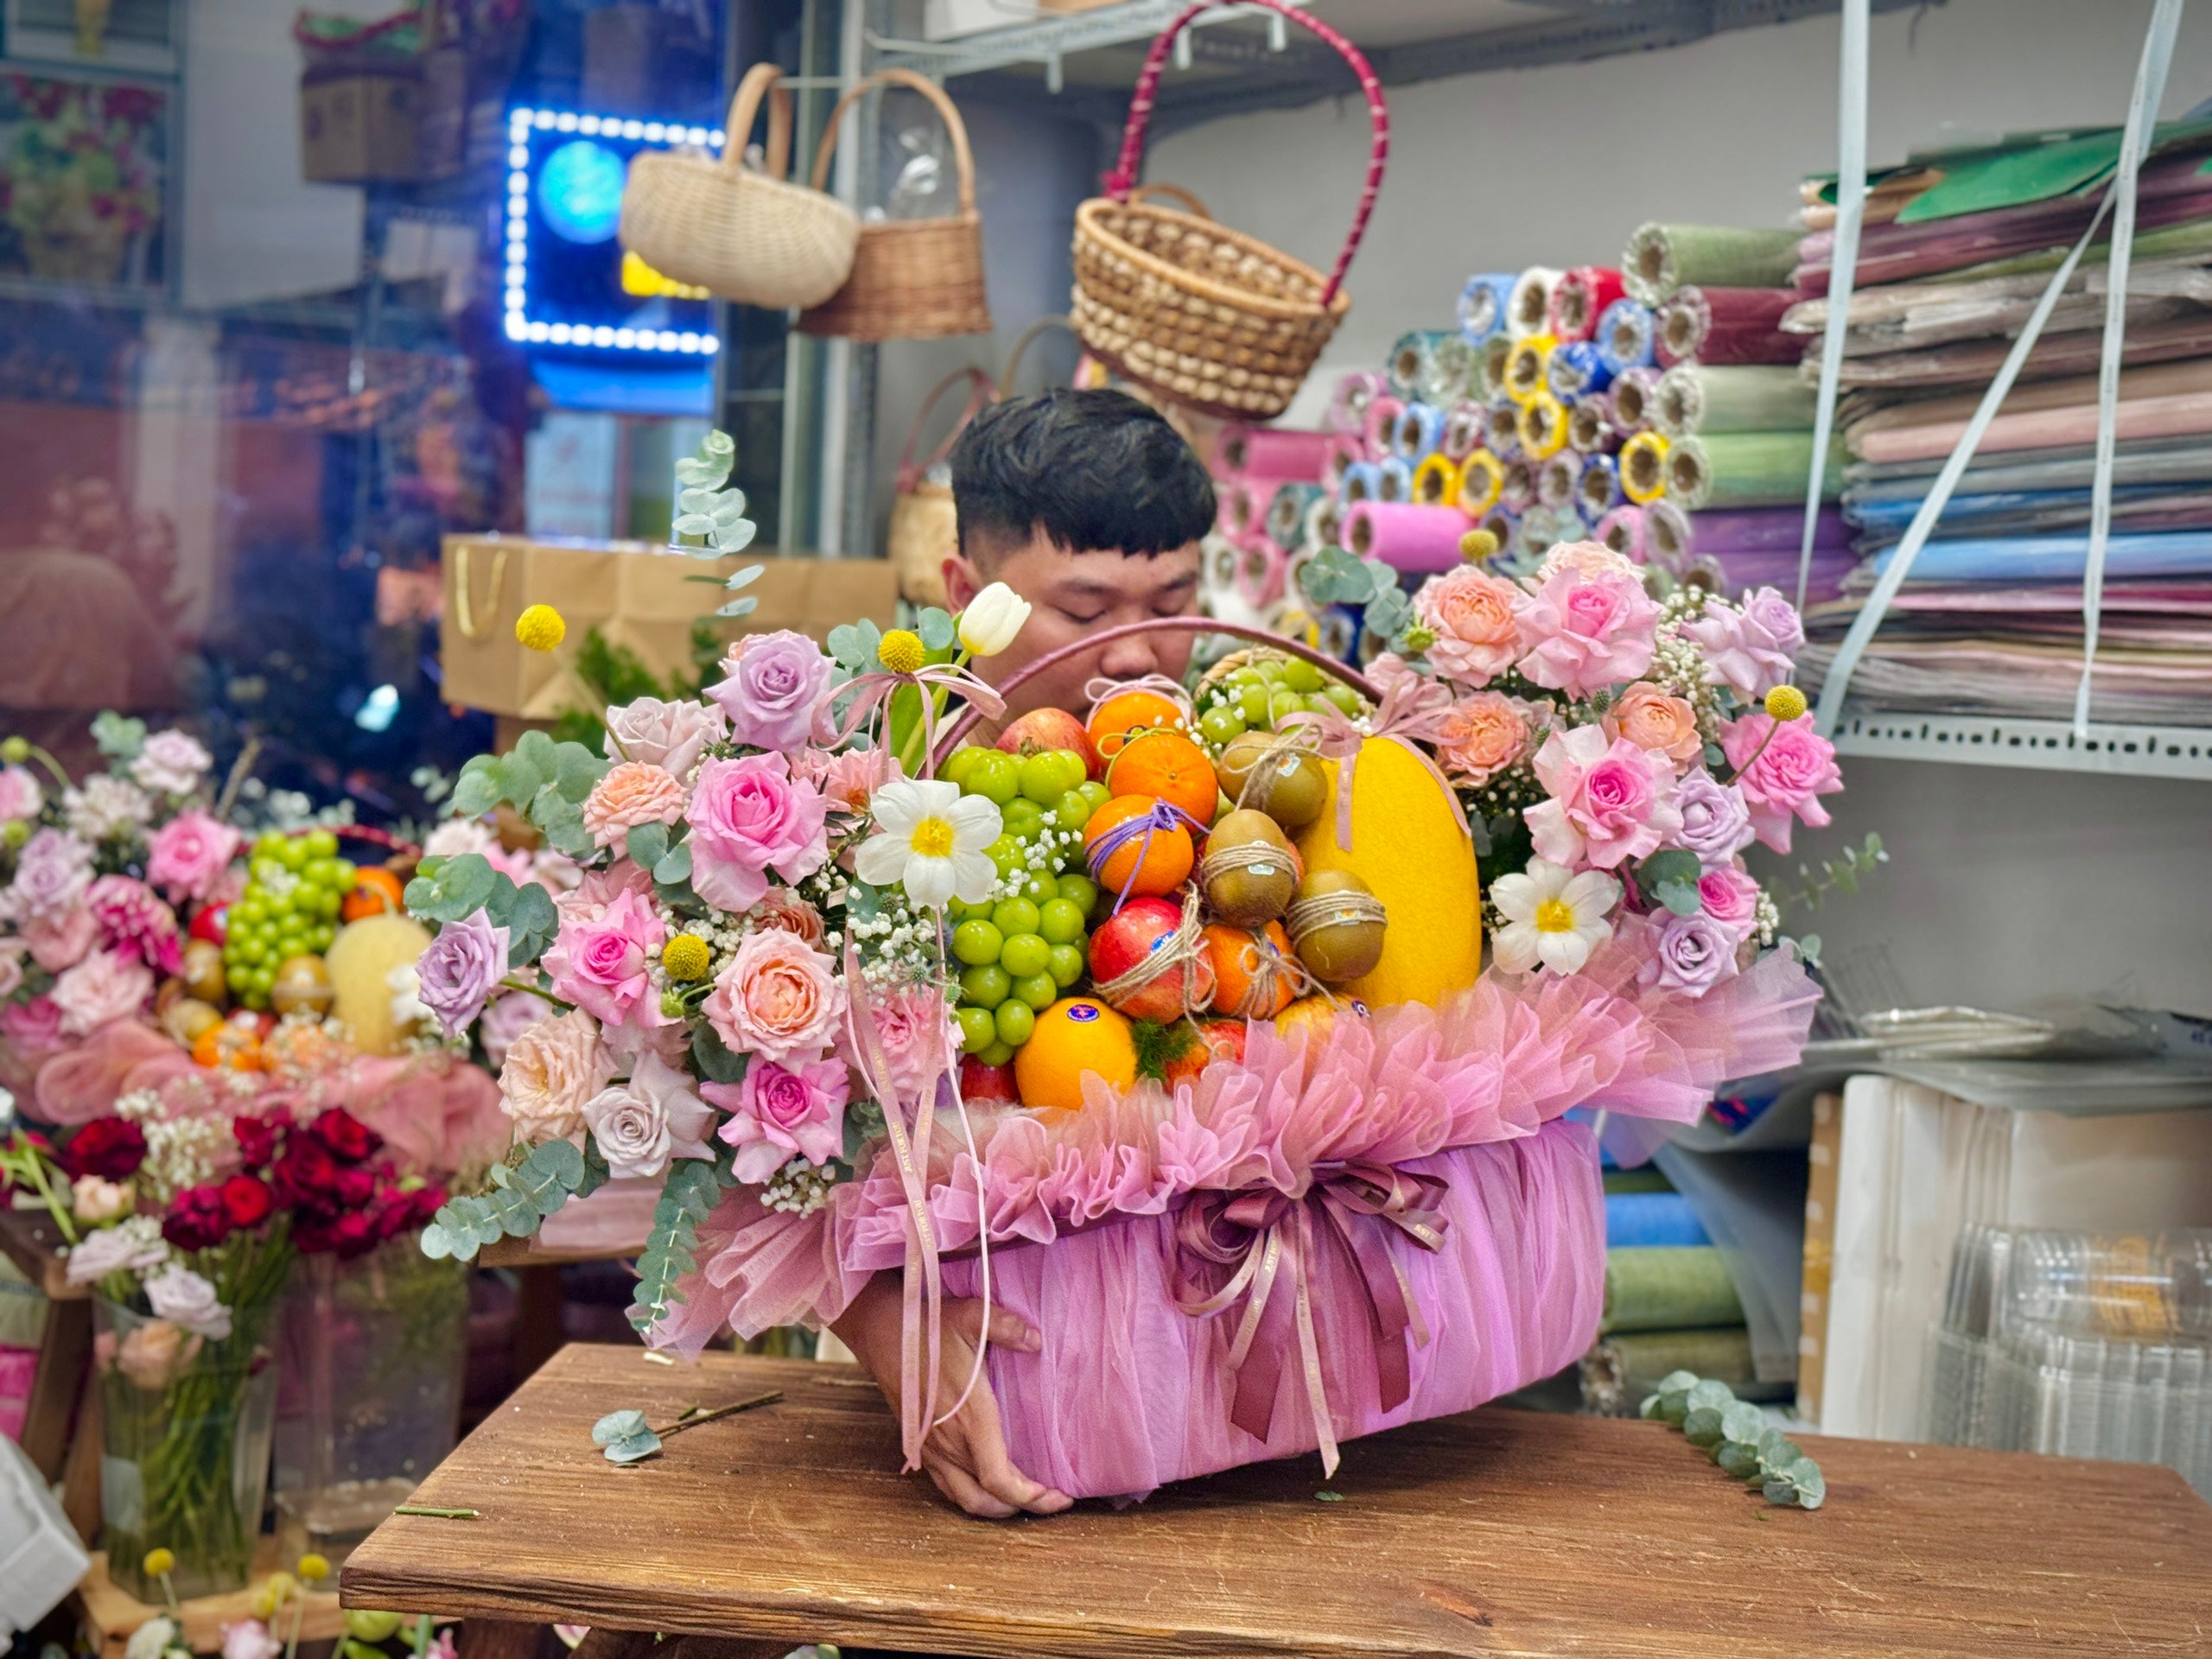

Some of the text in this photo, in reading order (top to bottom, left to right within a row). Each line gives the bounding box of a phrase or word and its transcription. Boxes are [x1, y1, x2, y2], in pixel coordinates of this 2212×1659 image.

[892, 1121, 912, 1173] JUST FOR YOU
